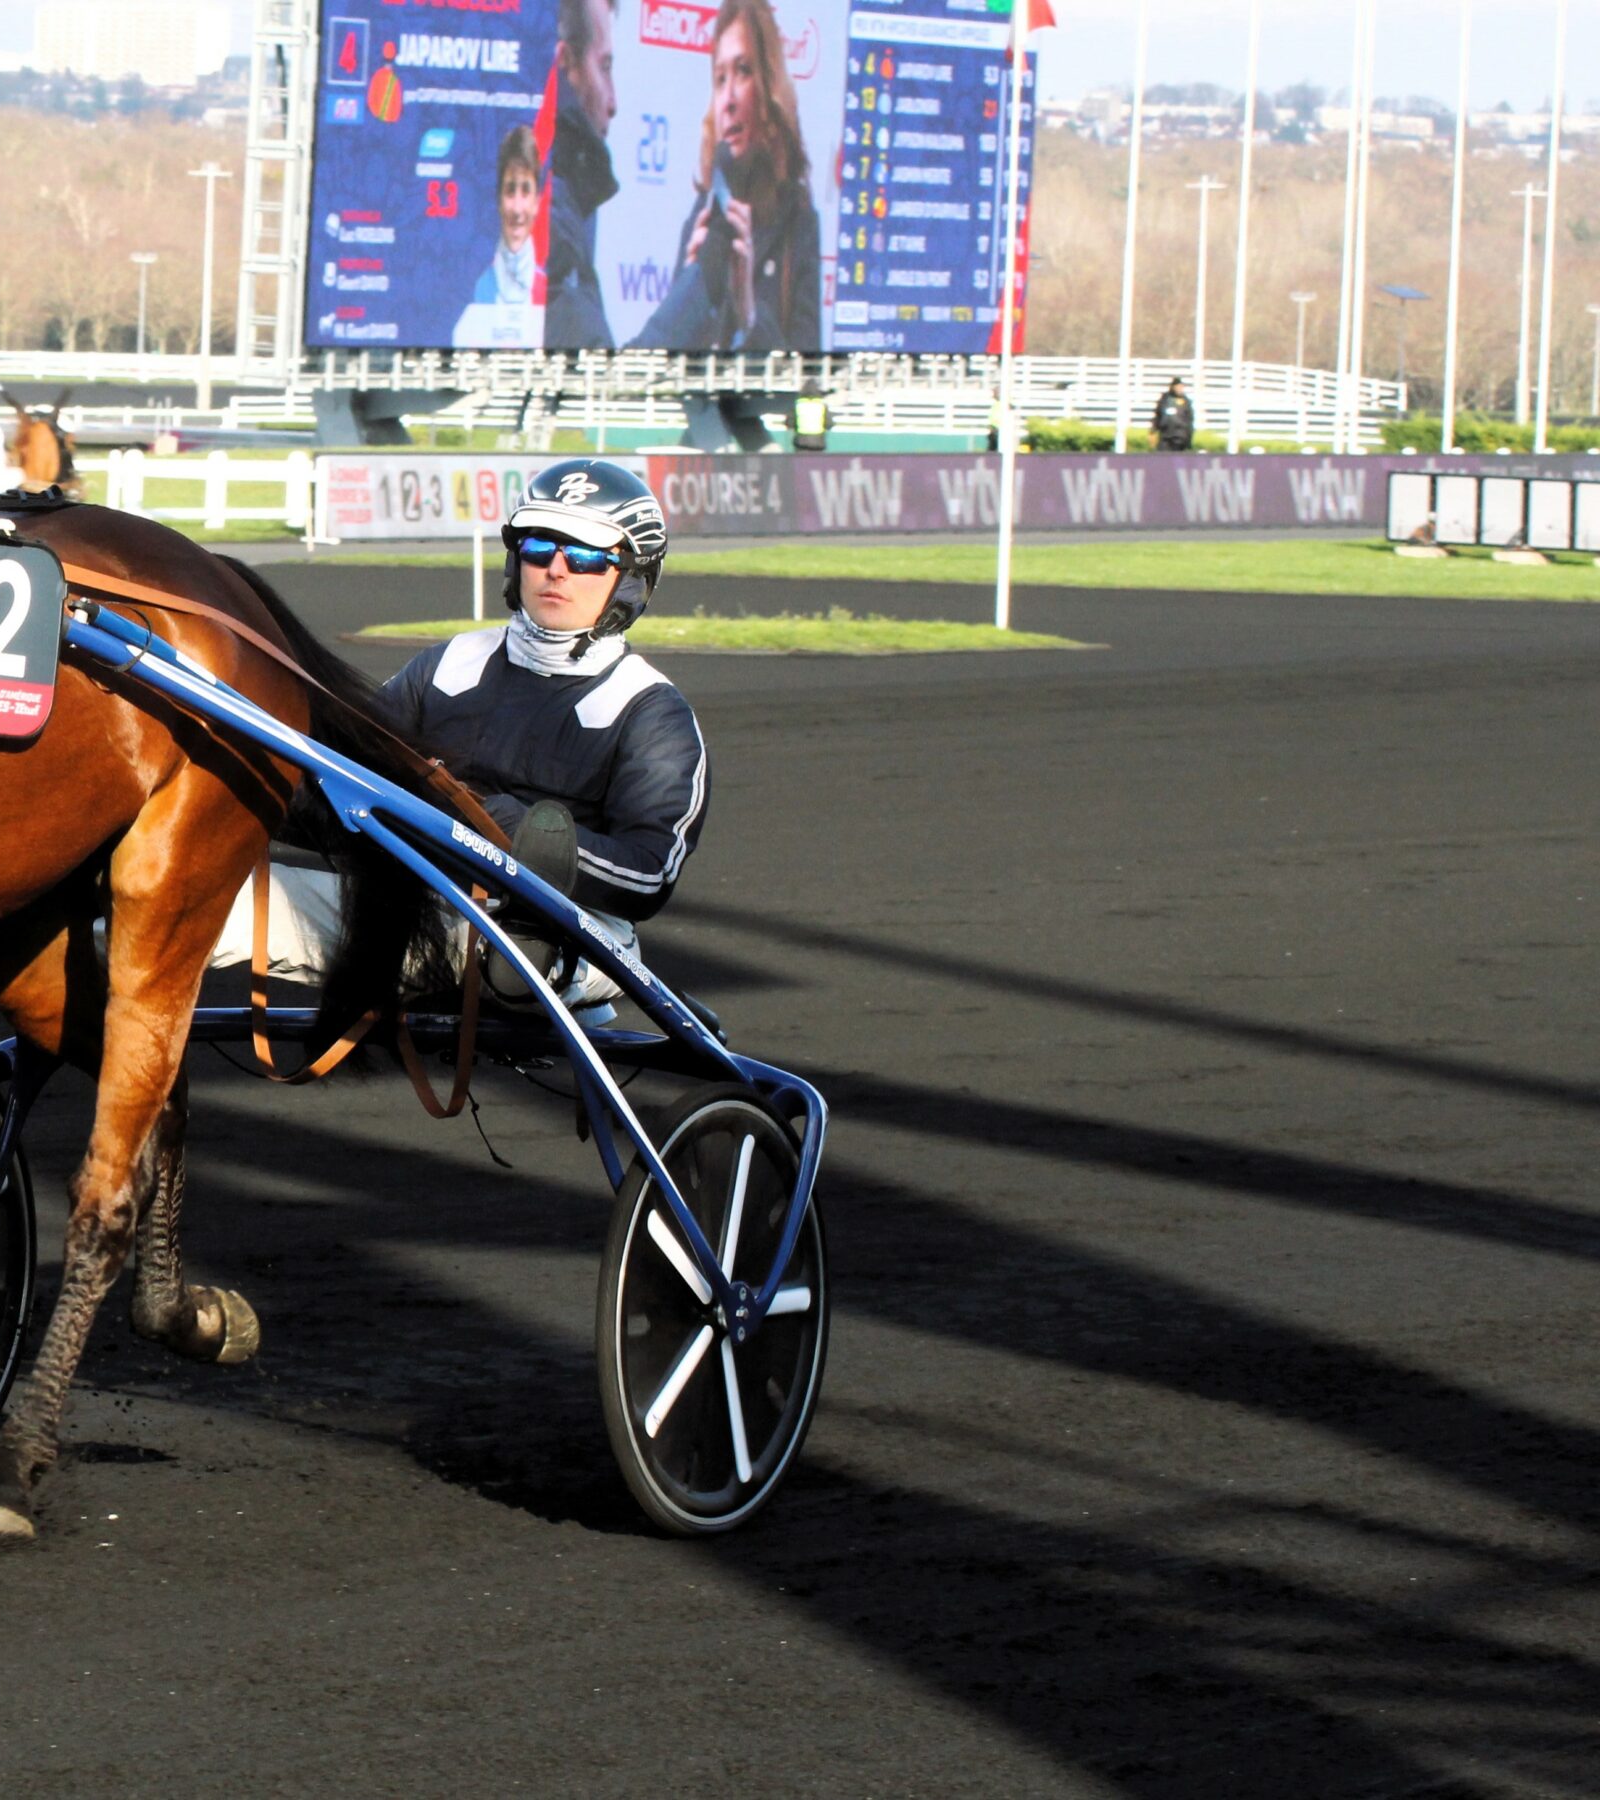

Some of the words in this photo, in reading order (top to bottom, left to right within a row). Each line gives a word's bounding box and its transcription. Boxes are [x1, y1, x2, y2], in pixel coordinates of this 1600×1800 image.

[338, 32, 357, 74] 4
[637, 113, 668, 172] 20
[861, 121, 872, 146] 2
[858, 191, 869, 215] 5
[402, 471, 421, 521] 2
[430, 474, 442, 519] 3
[477, 472, 498, 521] 5
[663, 471, 762, 515] COURSE
[767, 473, 782, 515] 4
[505, 855, 517, 876] B
